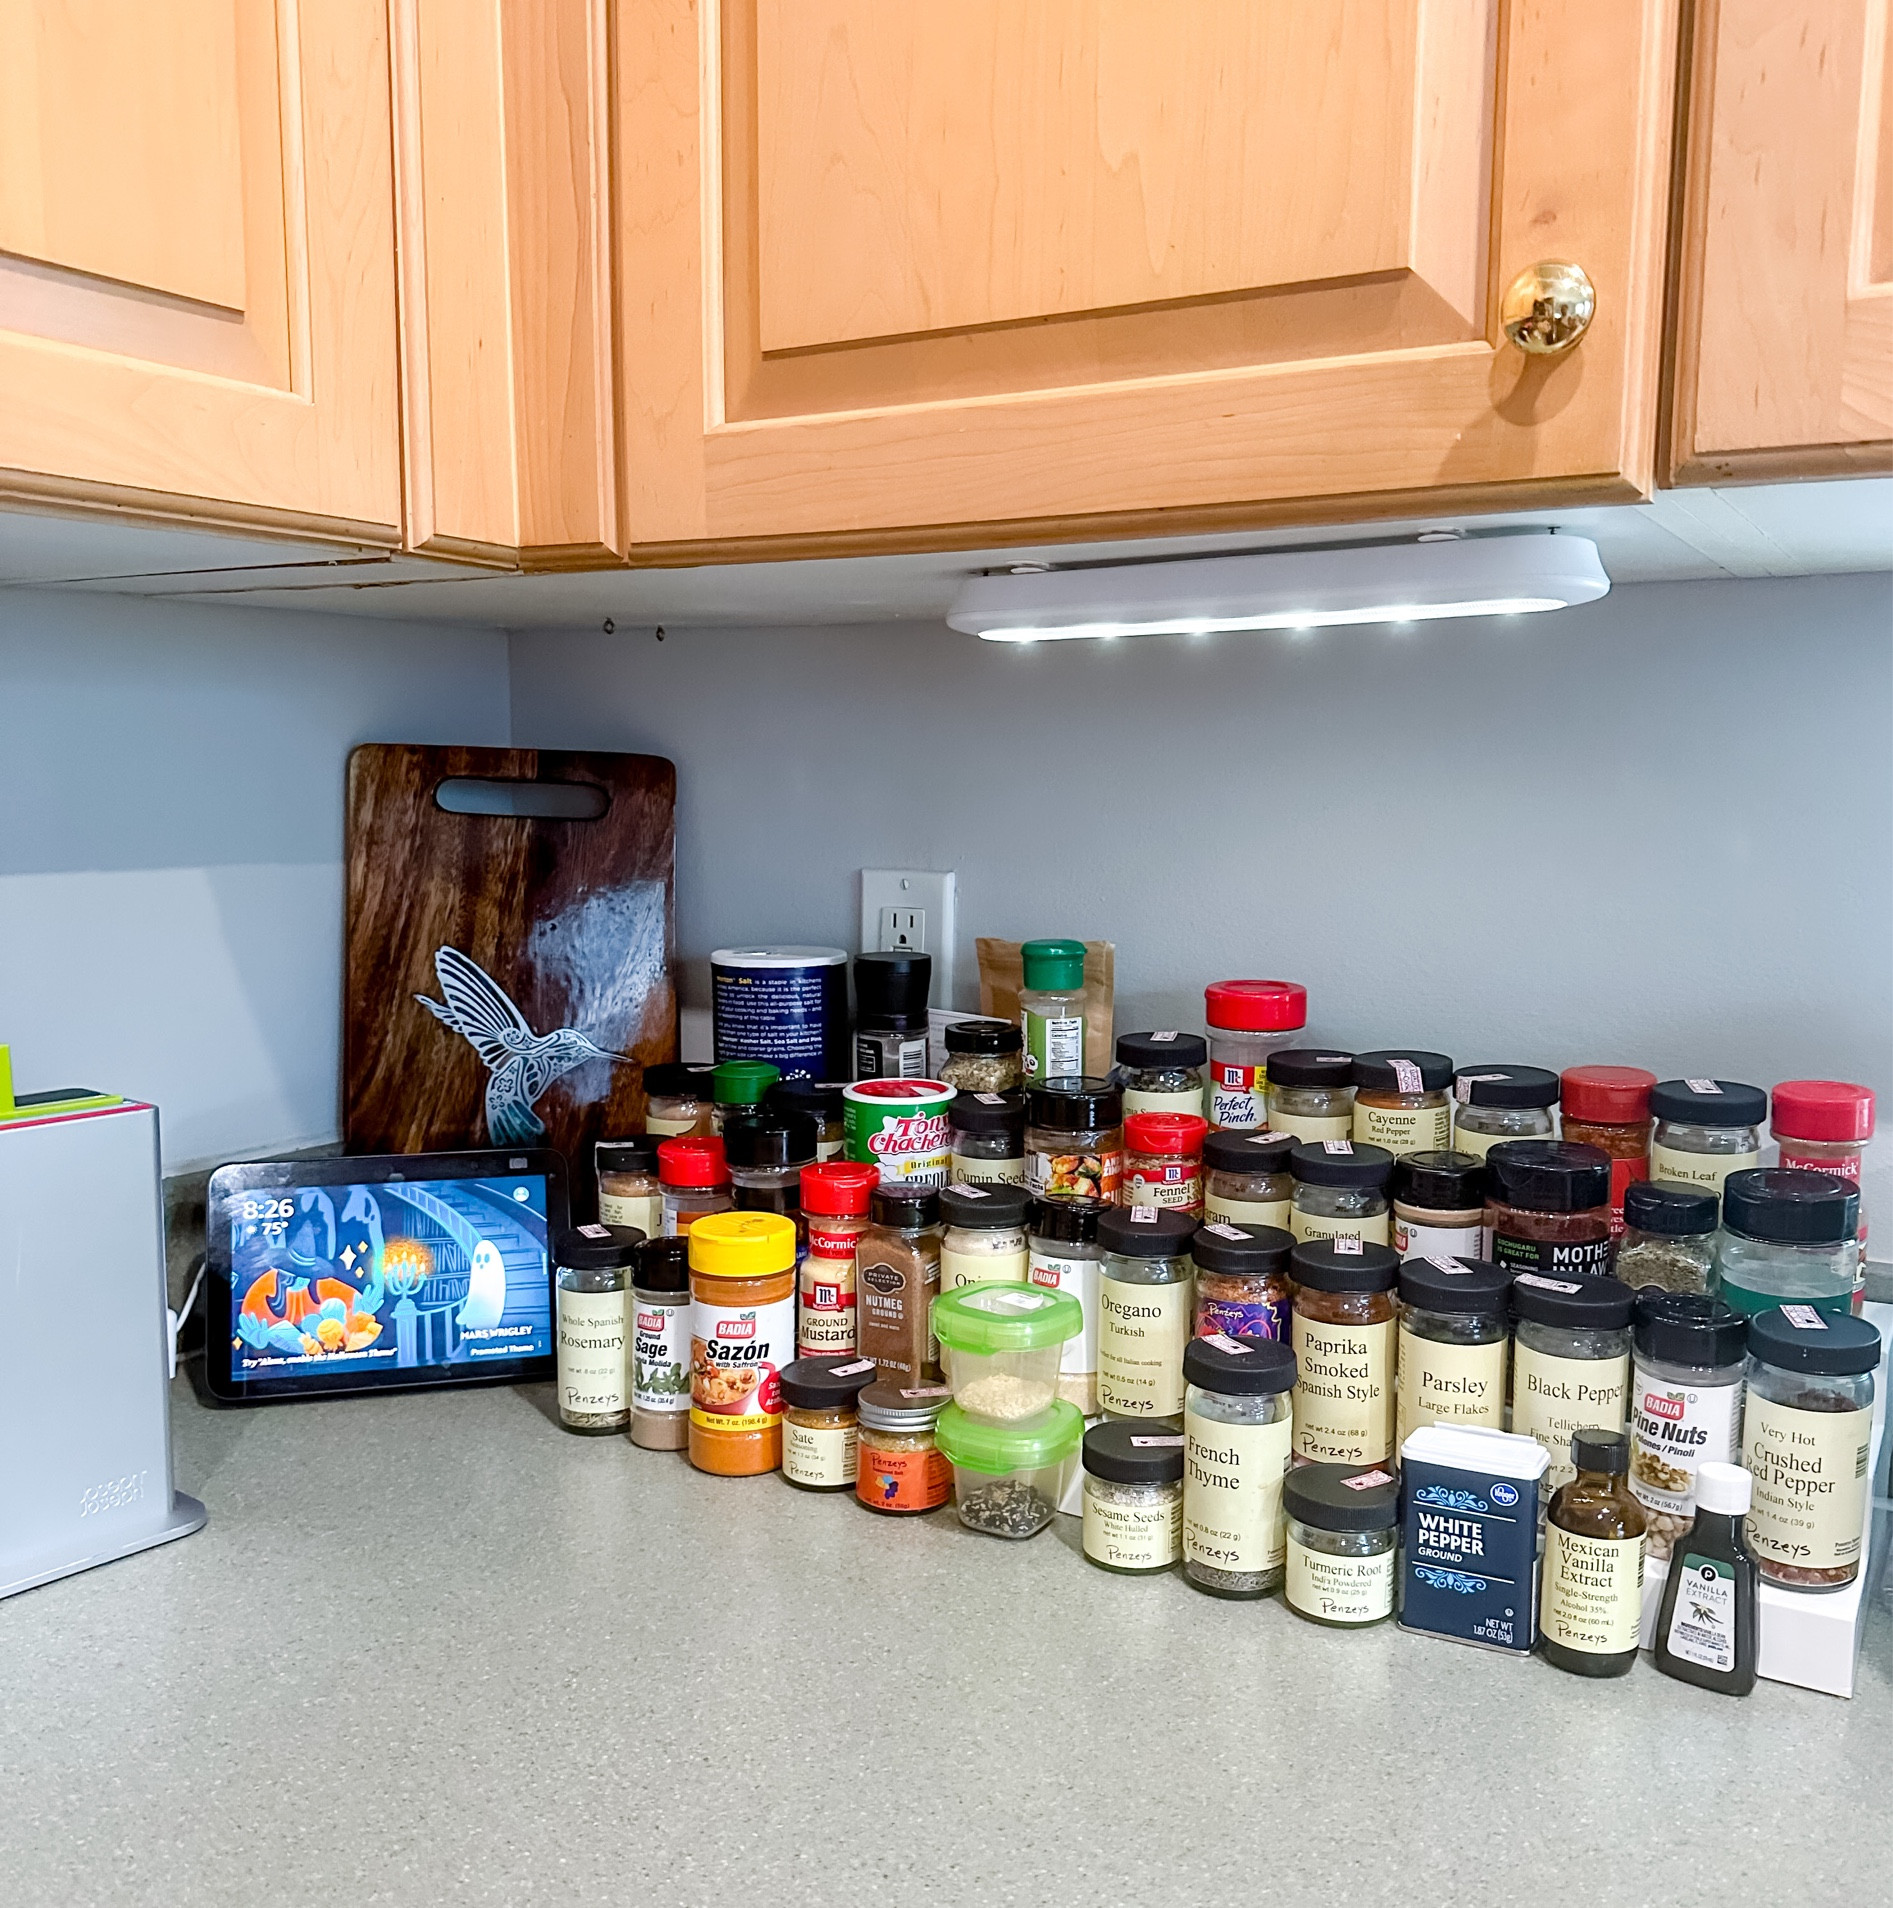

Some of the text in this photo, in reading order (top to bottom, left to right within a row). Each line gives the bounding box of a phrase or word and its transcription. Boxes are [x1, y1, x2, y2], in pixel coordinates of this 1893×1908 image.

[1214, 1096, 1255, 1112] Perfect
[1368, 1112, 1416, 1126] Cayenne
[1372, 1126, 1410, 1136] Red Pepper
[910, 1158, 948, 1169] Original
[1659, 1163, 1718, 1181] Broken Leaf
[956, 1167, 992, 1182] Cumin
[1153, 1183, 1190, 1197] Fennel
[242, 1198, 294, 1220] 8:26
[1305, 1227, 1360, 1240] Granulated
[1497, 1238, 1536, 1252] GOCHUGARU
[1504, 1248, 1524, 1258] GREAT
[868, 1271, 899, 1280] PRIVATE
[1510, 1262, 1538, 1272] SEASONING
[867, 1277, 901, 1286] SELECTION
[1033, 1269, 1058, 1285] BADIA
[866, 1294, 902, 1311] NUTMEG
[1102, 1293, 1162, 1319] Oregano
[1208, 1303, 1244, 1319] Penzeys
[562, 1314, 624, 1328] Whole Spanish
[638, 1316, 662, 1329] BADIA
[806, 1318, 848, 1326] GROUND
[872, 1309, 897, 1319] GROUND
[461, 1325, 533, 1340] MARS WRIGLEY
[640, 1330, 661, 1340] Ground
[718, 1322, 753, 1335] BADIA
[801, 1325, 855, 1341] Mustard
[1109, 1322, 1145, 1337] Turkish
[560, 1330, 625, 1350] Rosemary
[635, 1336, 667, 1358] Sage
[1305, 1332, 1368, 1357] Paprika
[706, 1339, 770, 1361] Sazón
[648, 1359, 672, 1367] Molida
[732, 1361, 758, 1369] Saffron
[1304, 1356, 1369, 1378] Smoked
[1296, 1374, 1380, 1402] Spanish Style
[1422, 1371, 1488, 1397] Parsley
[1528, 1374, 1623, 1405] Black Pepper
[565, 1386, 619, 1406] Penzeys
[1101, 1384, 1154, 1414] Penzeys
[1418, 1396, 1490, 1414] Large Flakes
[1646, 1398, 1680, 1416] BADIA
[1315, 1425, 1323, 1433] wt
[1324, 1426, 1336, 1435] 2.4
[1348, 1428, 1359, 1438] (68
[1360, 1429, 1368, 1438] g)
[1530, 1427, 1550, 1443] Fine
[1633, 1407, 1708, 1446] Pine Nuts
[1760, 1422, 1816, 1446] Very Hot
[792, 1430, 814, 1445] Sate
[1300, 1431, 1363, 1462] Penzeys
[1188, 1434, 1240, 1466] French
[1668, 1445, 1695, 1458] Pinoli
[1754, 1442, 1822, 1473] Crushed
[870, 1452, 907, 1468] Penzeys
[789, 1461, 824, 1479] Penzeys
[1188, 1458, 1240, 1490] Thyme
[1746, 1454, 1835, 1496] Red Pepper
[1756, 1486, 1815, 1512] Indian Style
[1092, 1502, 1165, 1522] Sesame Seeds
[1104, 1520, 1123, 1531] White
[1418, 1512, 1482, 1539] WHITE
[1791, 1518, 1804, 1527] (39
[1806, 1521, 1815, 1529] g)
[1200, 1524, 1241, 1542] 0.8 oz (22 g)
[1418, 1528, 1484, 1556] PEPPER
[1745, 1517, 1811, 1560] Penzeys
[1106, 1544, 1152, 1563] Penzeys
[1184, 1526, 1240, 1564] Penzeys
[1418, 1546, 1463, 1562] GROUND
[1558, 1534, 1619, 1557] Mexican
[1302, 1554, 1382, 1577] Turmeric Root
[1561, 1550, 1614, 1573] Vanilla
[1333, 1578, 1372, 1587] Powdered
[1560, 1565, 1612, 1588] Extract
[1554, 1581, 1618, 1604] Single-Strength
[1686, 1579, 1728, 1597] VANILLA
[1686, 1587, 1726, 1605] EXTRACT
[1319, 1597, 1370, 1616] Penzeys
[1560, 1599, 1587, 1612] Alcohol
[1562, 1611, 1573, 1620] 2.0
[1485, 1618, 1514, 1632] NET WT
[1555, 1619, 1608, 1646] Penzeys
[1473, 1625, 1513, 1644] 1.87 OZ (53g)
